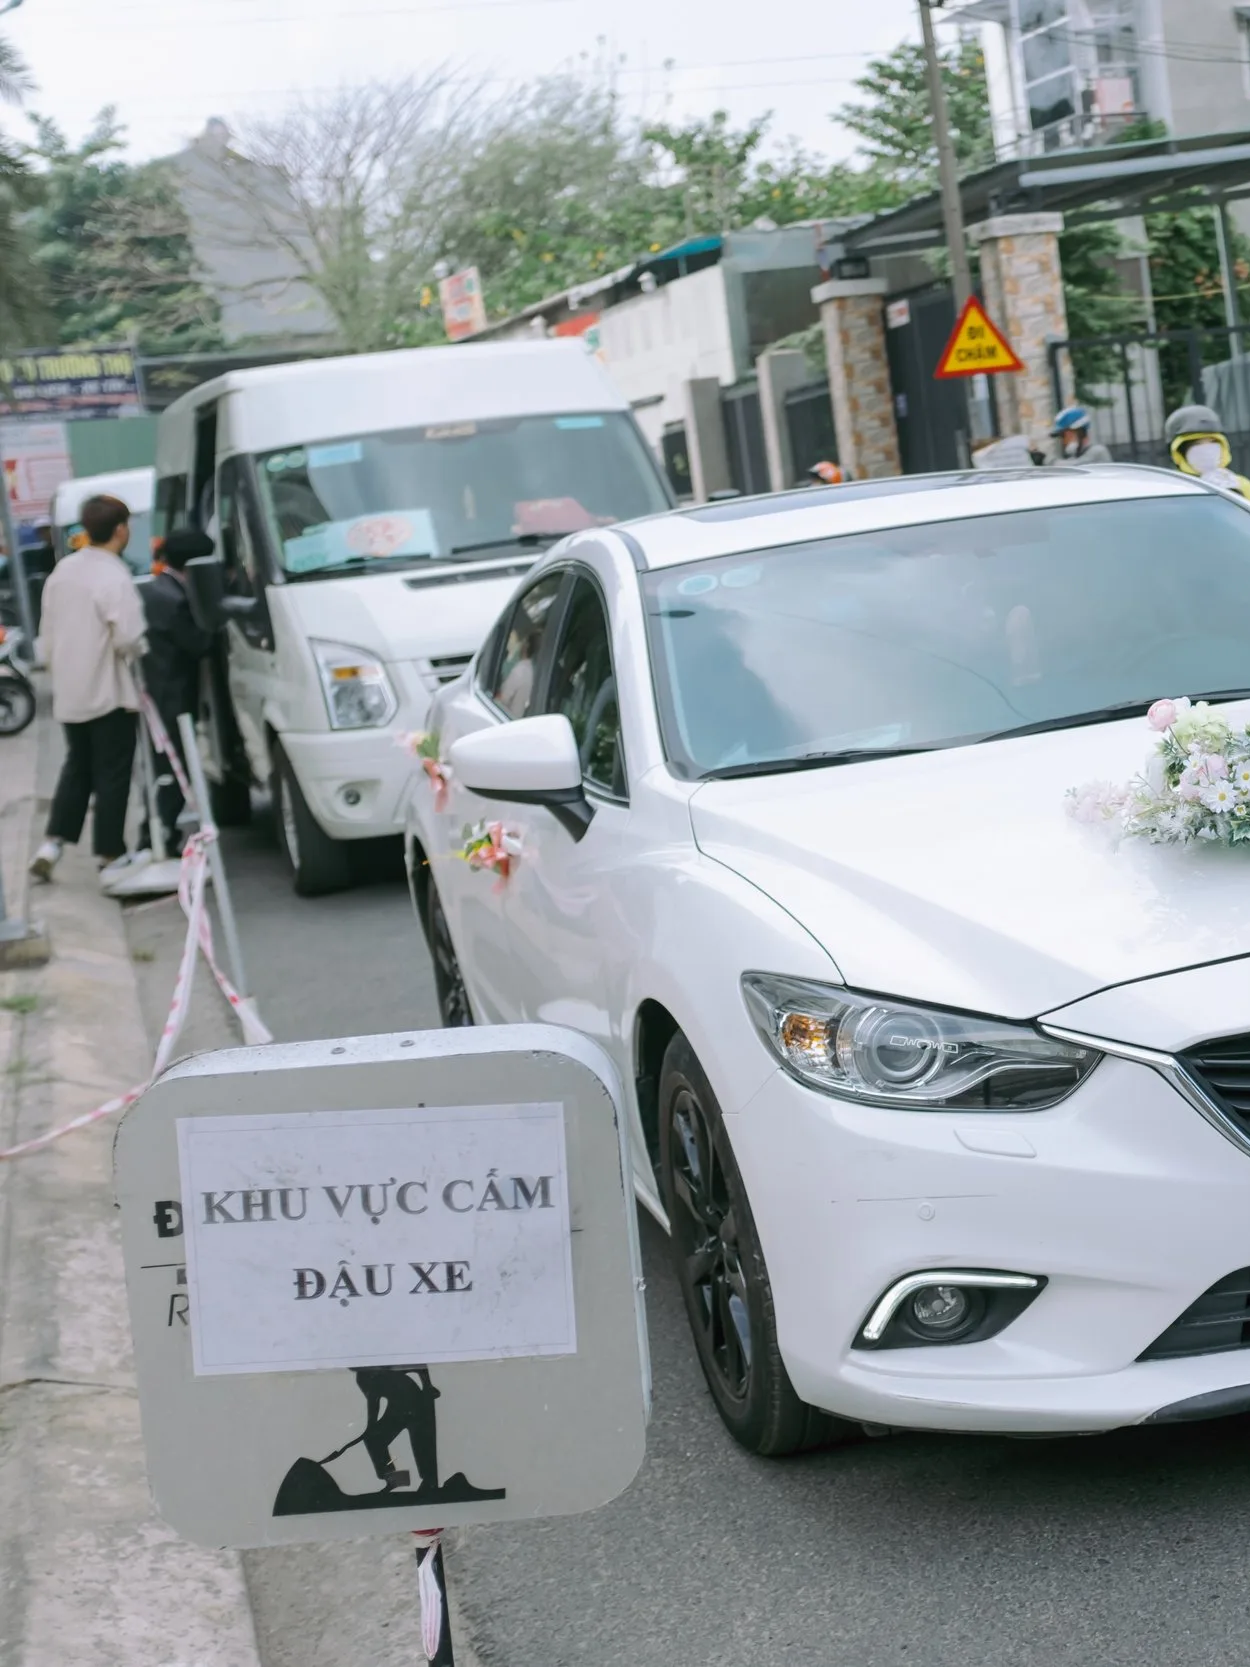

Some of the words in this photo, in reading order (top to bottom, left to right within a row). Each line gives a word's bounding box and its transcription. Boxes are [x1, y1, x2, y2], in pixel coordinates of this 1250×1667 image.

[200, 1187, 309, 1224] KHU
[321, 1177, 428, 1226] VỰC
[442, 1168, 555, 1213] CẤM
[293, 1260, 396, 1307] ĐẬU
[408, 1261, 473, 1294] XE
